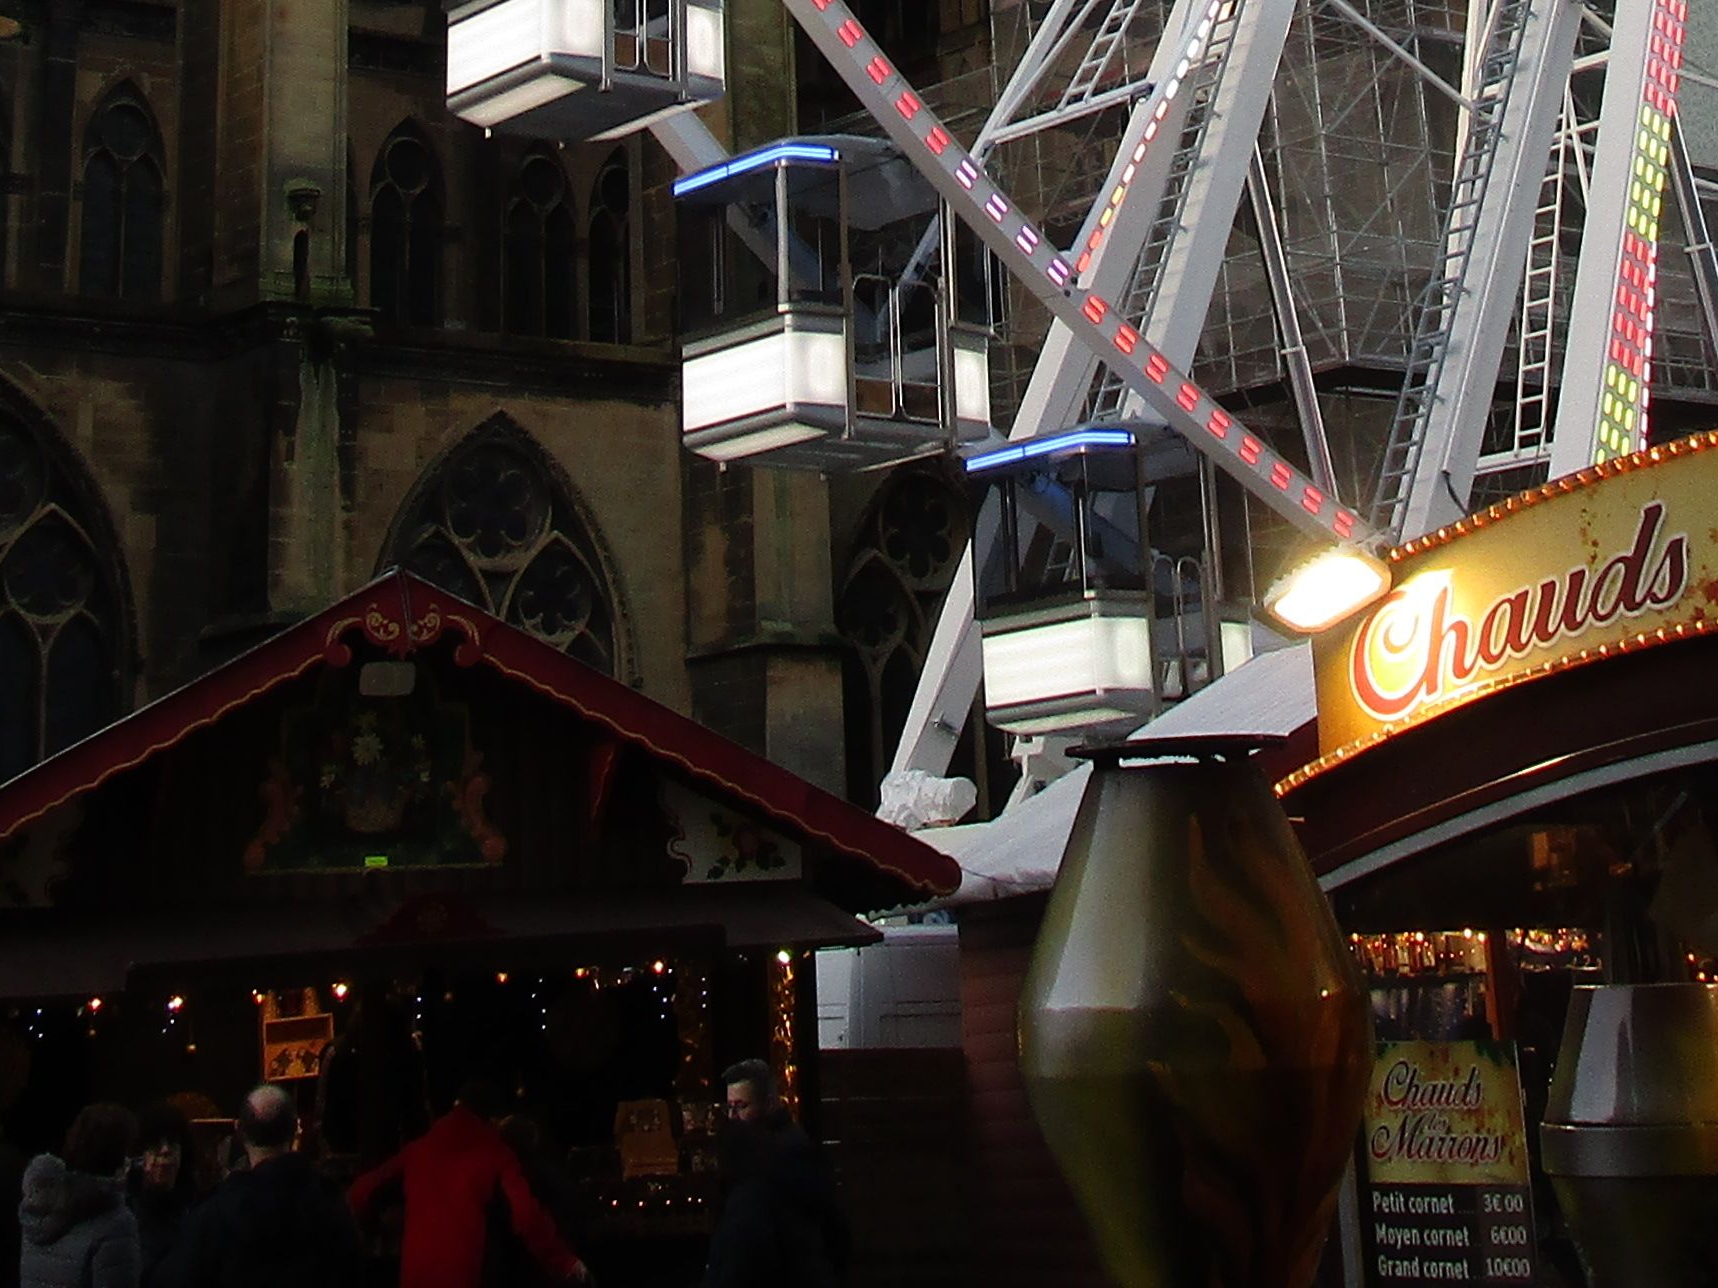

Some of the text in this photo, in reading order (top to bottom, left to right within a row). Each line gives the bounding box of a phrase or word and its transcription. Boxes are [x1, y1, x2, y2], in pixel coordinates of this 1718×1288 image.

[1349, 500, 1687, 720] Chauds
[1382, 1059, 1482, 1110] Chauds
[1370, 1112, 1502, 1162] Marrons
[1372, 1191, 1406, 1214] Petit
[1408, 1193, 1455, 1215] cornet
[1374, 1222, 1421, 1250] Moyen
[1423, 1225, 1470, 1247] cornet
[1377, 1253, 1421, 1278] Grand
[1423, 1257, 1470, 1280] cornet
